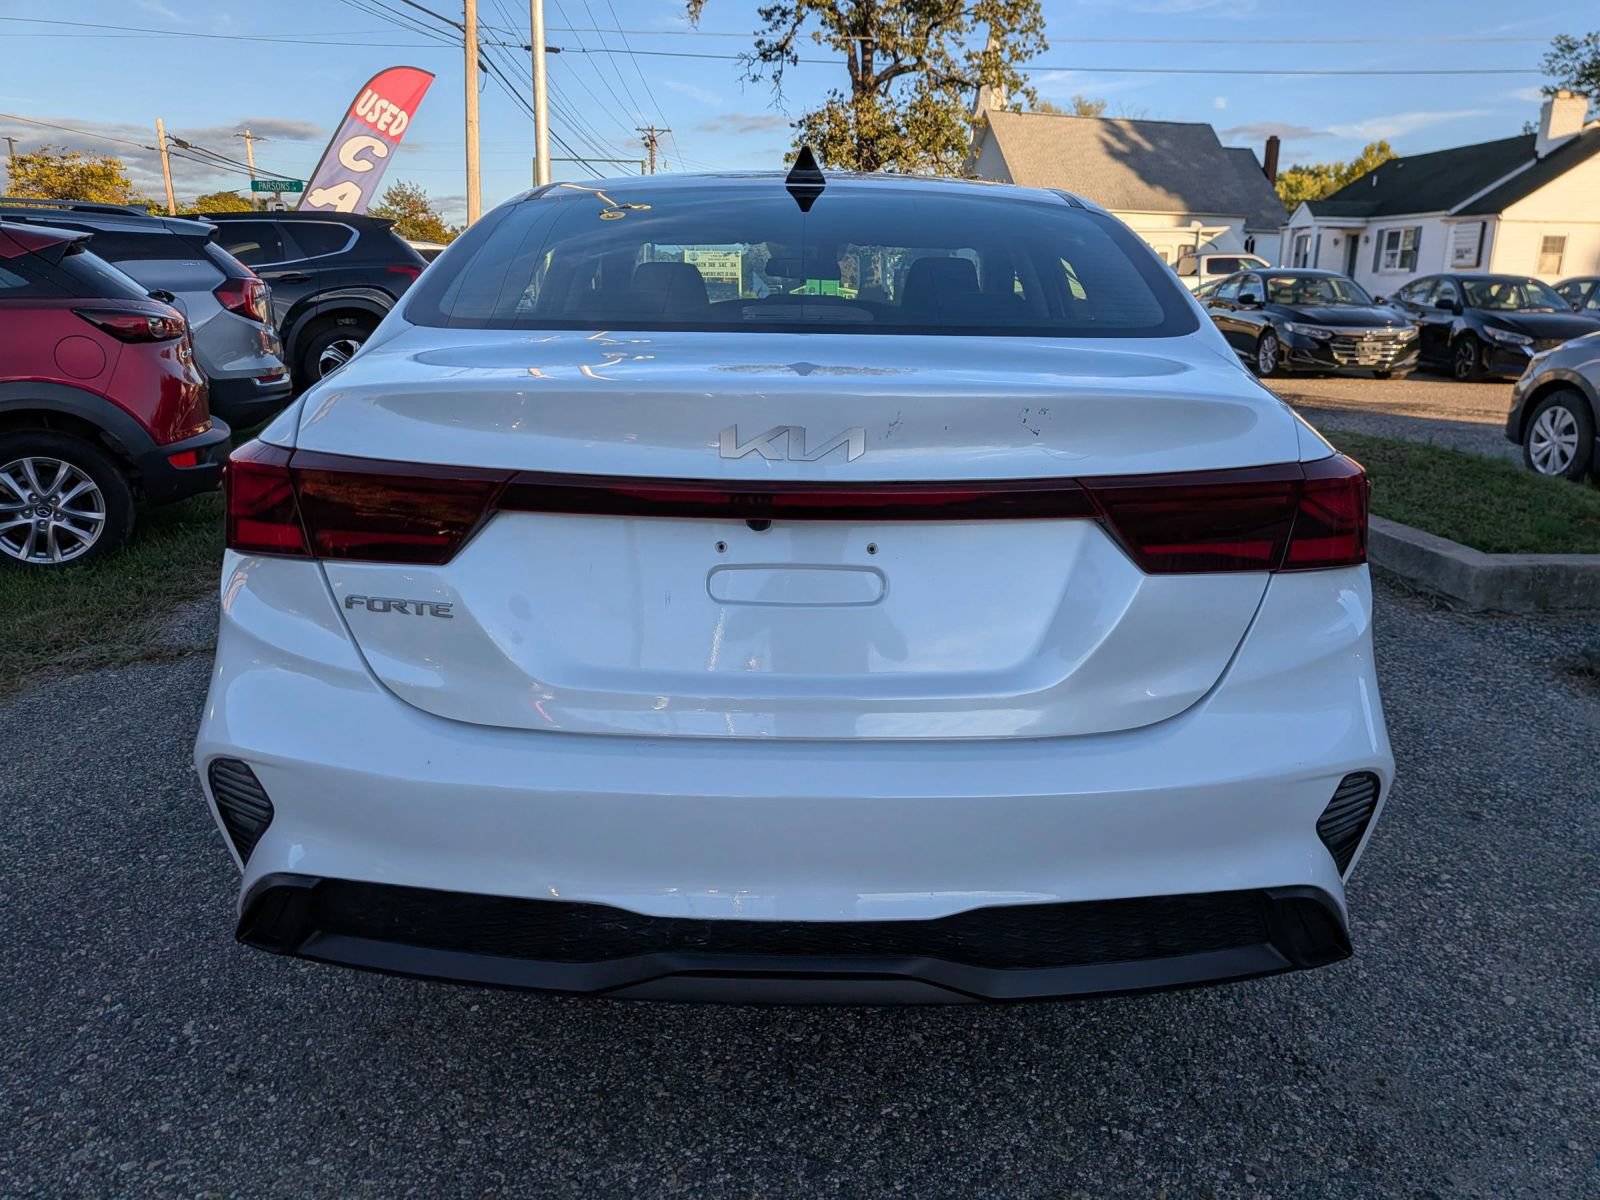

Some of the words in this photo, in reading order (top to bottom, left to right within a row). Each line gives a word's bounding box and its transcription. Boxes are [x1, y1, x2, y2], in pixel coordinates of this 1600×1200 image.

[355, 89, 409, 137] USED
[258, 181, 290, 191] PARSONS
[719, 423, 866, 463] KIA
[344, 593, 454, 619] FORTE
